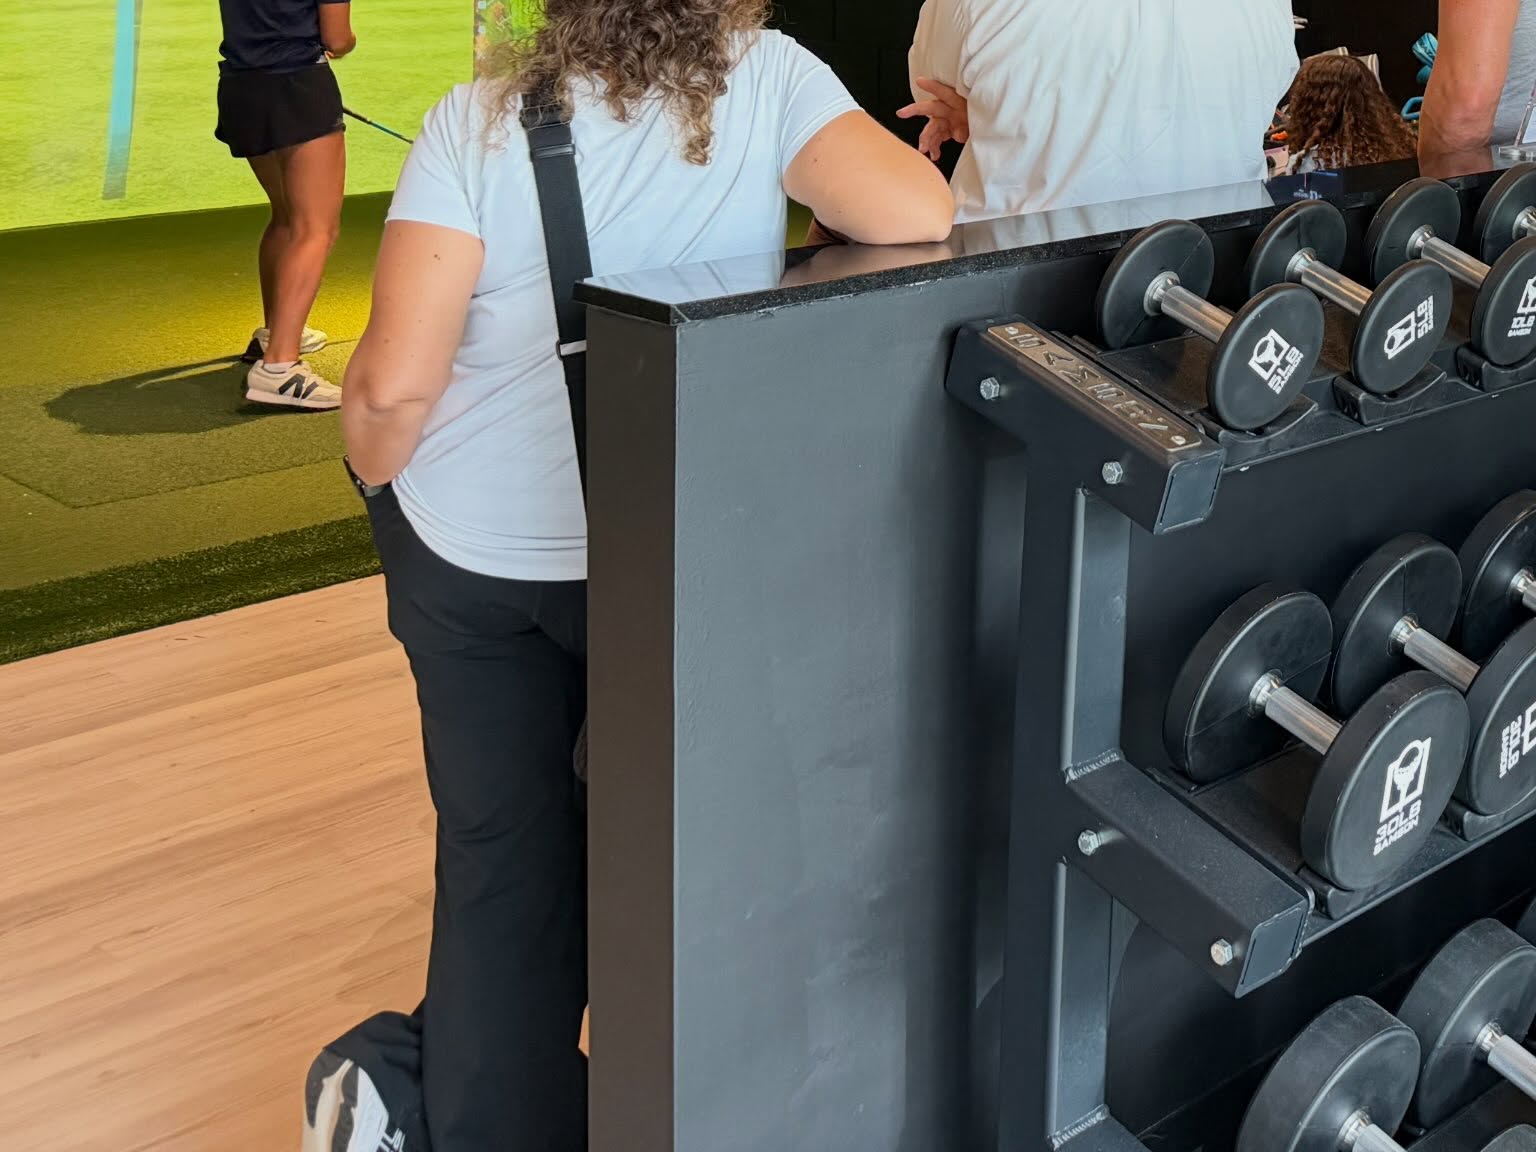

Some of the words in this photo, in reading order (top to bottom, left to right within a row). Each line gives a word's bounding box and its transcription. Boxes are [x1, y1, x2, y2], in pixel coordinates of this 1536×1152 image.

[1417, 299, 1429, 339] 5LB
[1511, 315, 1536, 329] 10LB
[1267, 346, 1300, 389] 5LB
[1272, 352, 1304, 395] SAMSON
[1507, 714, 1522, 771] 30LB
[1373, 815, 1419, 856] SAMSON
[1375, 799, 1422, 844] 30LB
